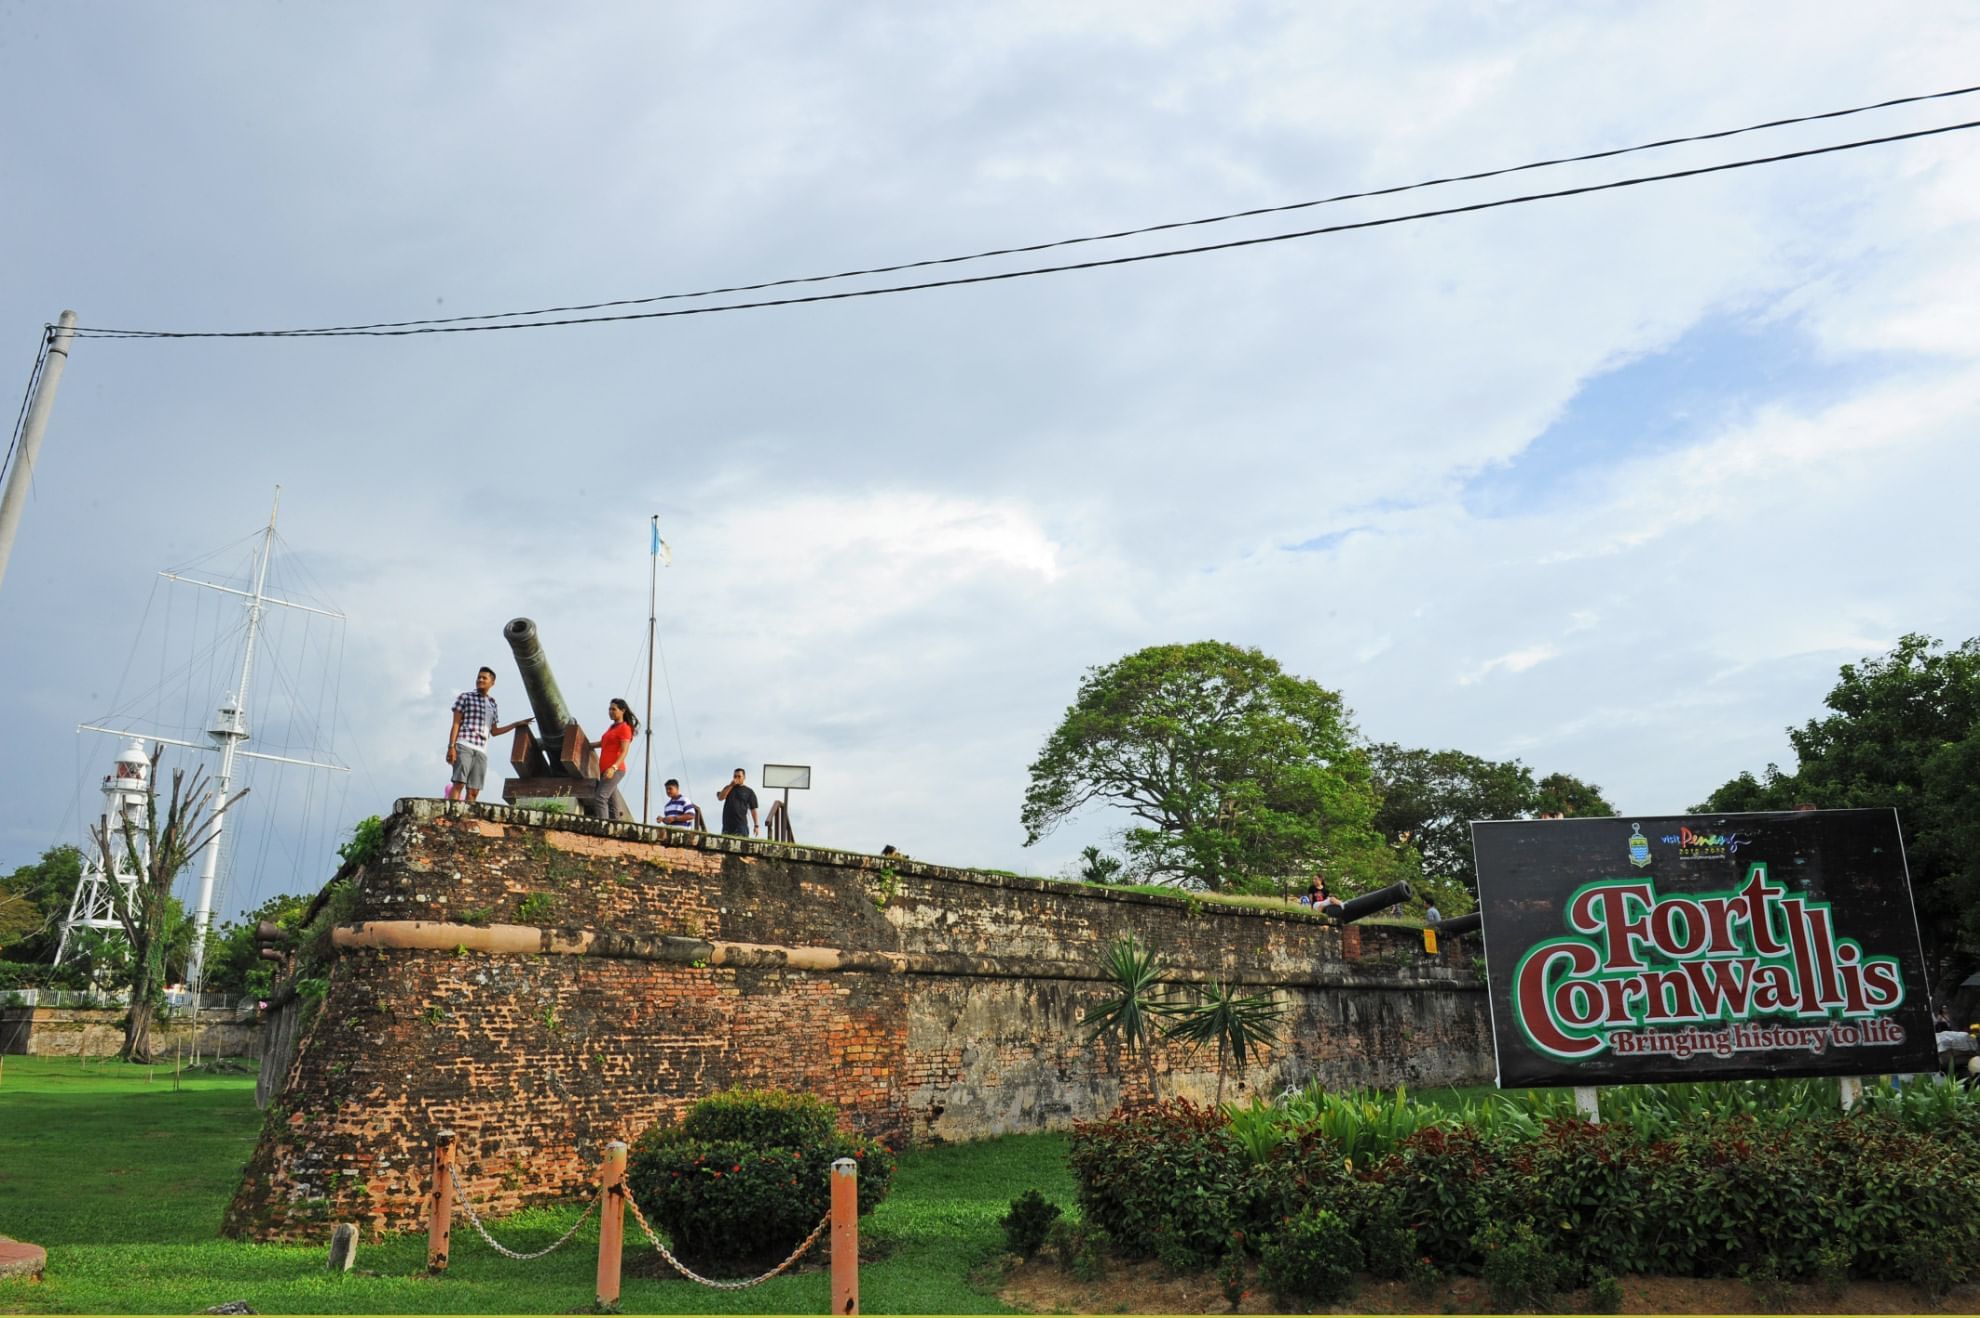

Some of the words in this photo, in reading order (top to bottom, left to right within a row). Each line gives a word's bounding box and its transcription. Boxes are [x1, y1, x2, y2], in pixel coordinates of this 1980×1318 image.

[1680, 827, 1752, 853] Penang
[1570, 868, 1790, 973] Fort
[1518, 898, 1902, 1057] Cornwallis
[1609, 1027, 1732, 1058] Bringing
[1733, 1022, 1826, 1053] history
[1831, 1022, 1859, 1045] to
[1861, 1018, 1904, 1045] life
